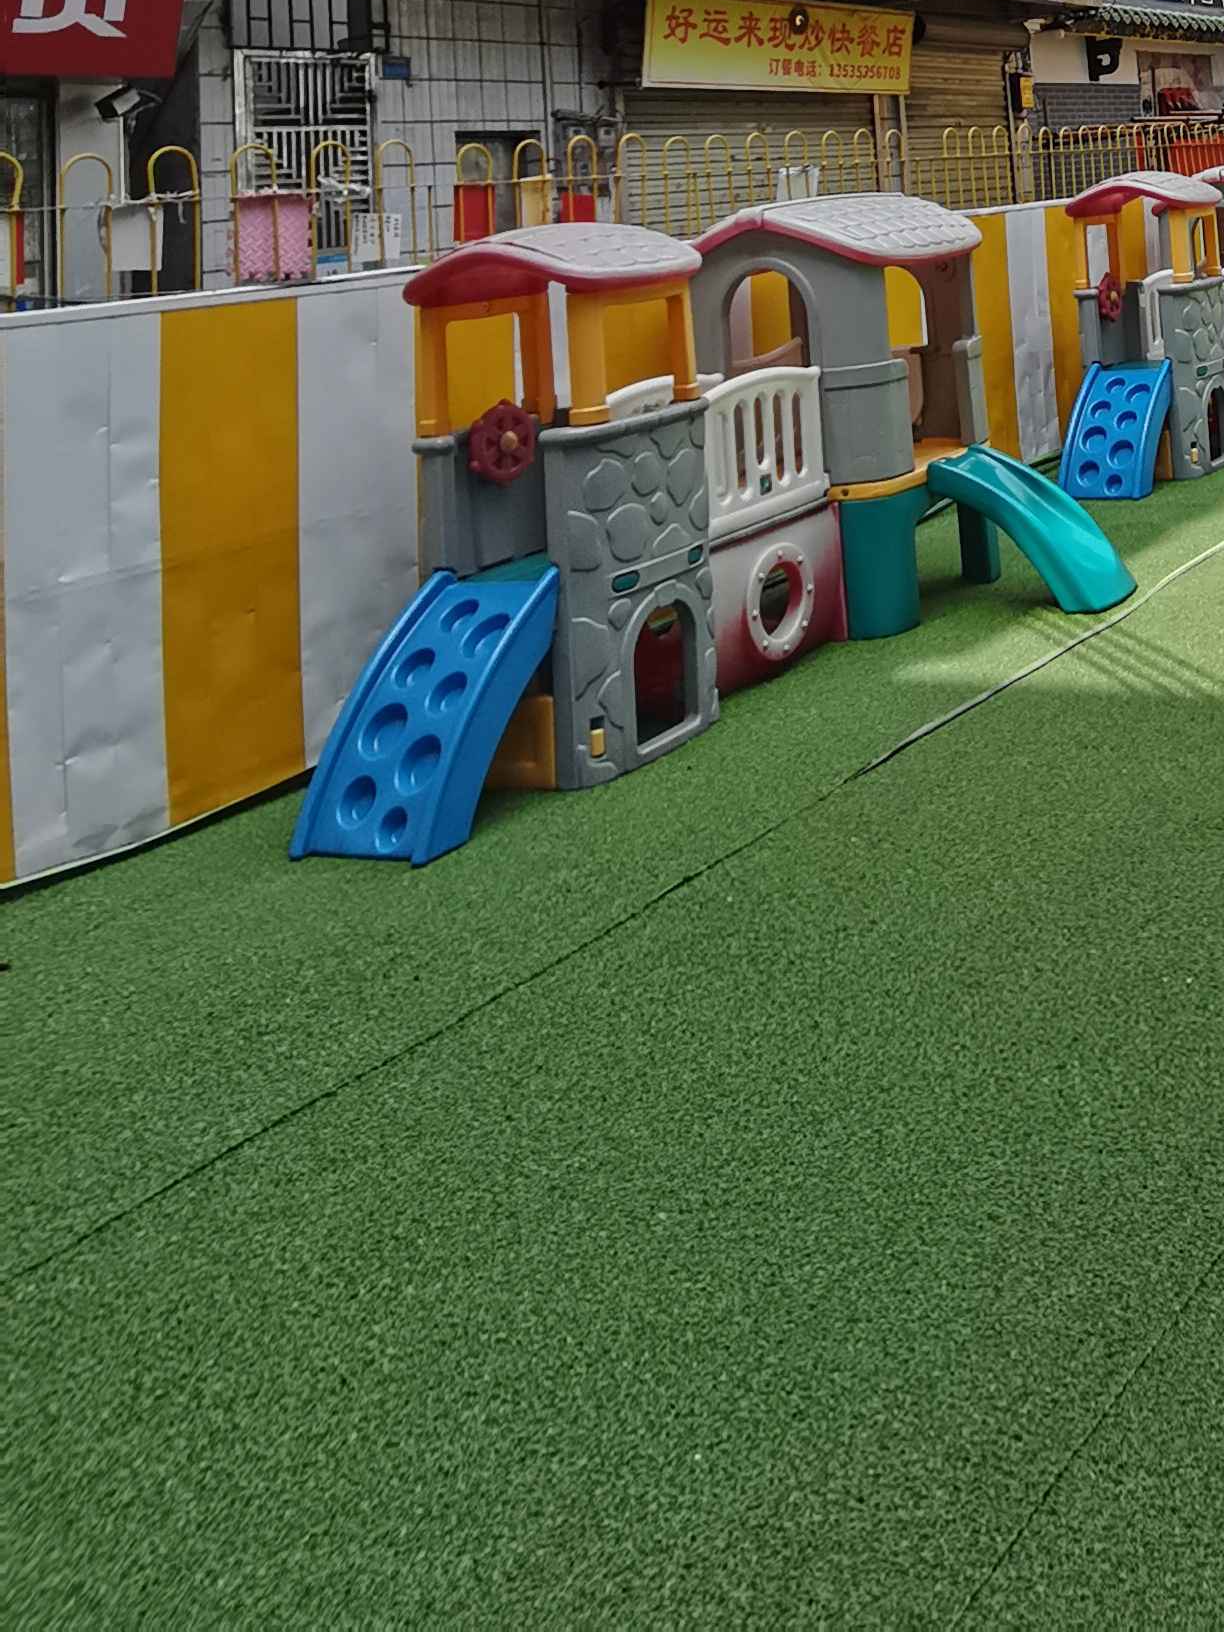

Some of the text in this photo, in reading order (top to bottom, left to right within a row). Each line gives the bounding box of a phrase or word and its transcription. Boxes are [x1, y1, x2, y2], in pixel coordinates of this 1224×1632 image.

[663, 4, 906, 59] 好运来现炒快餐店
